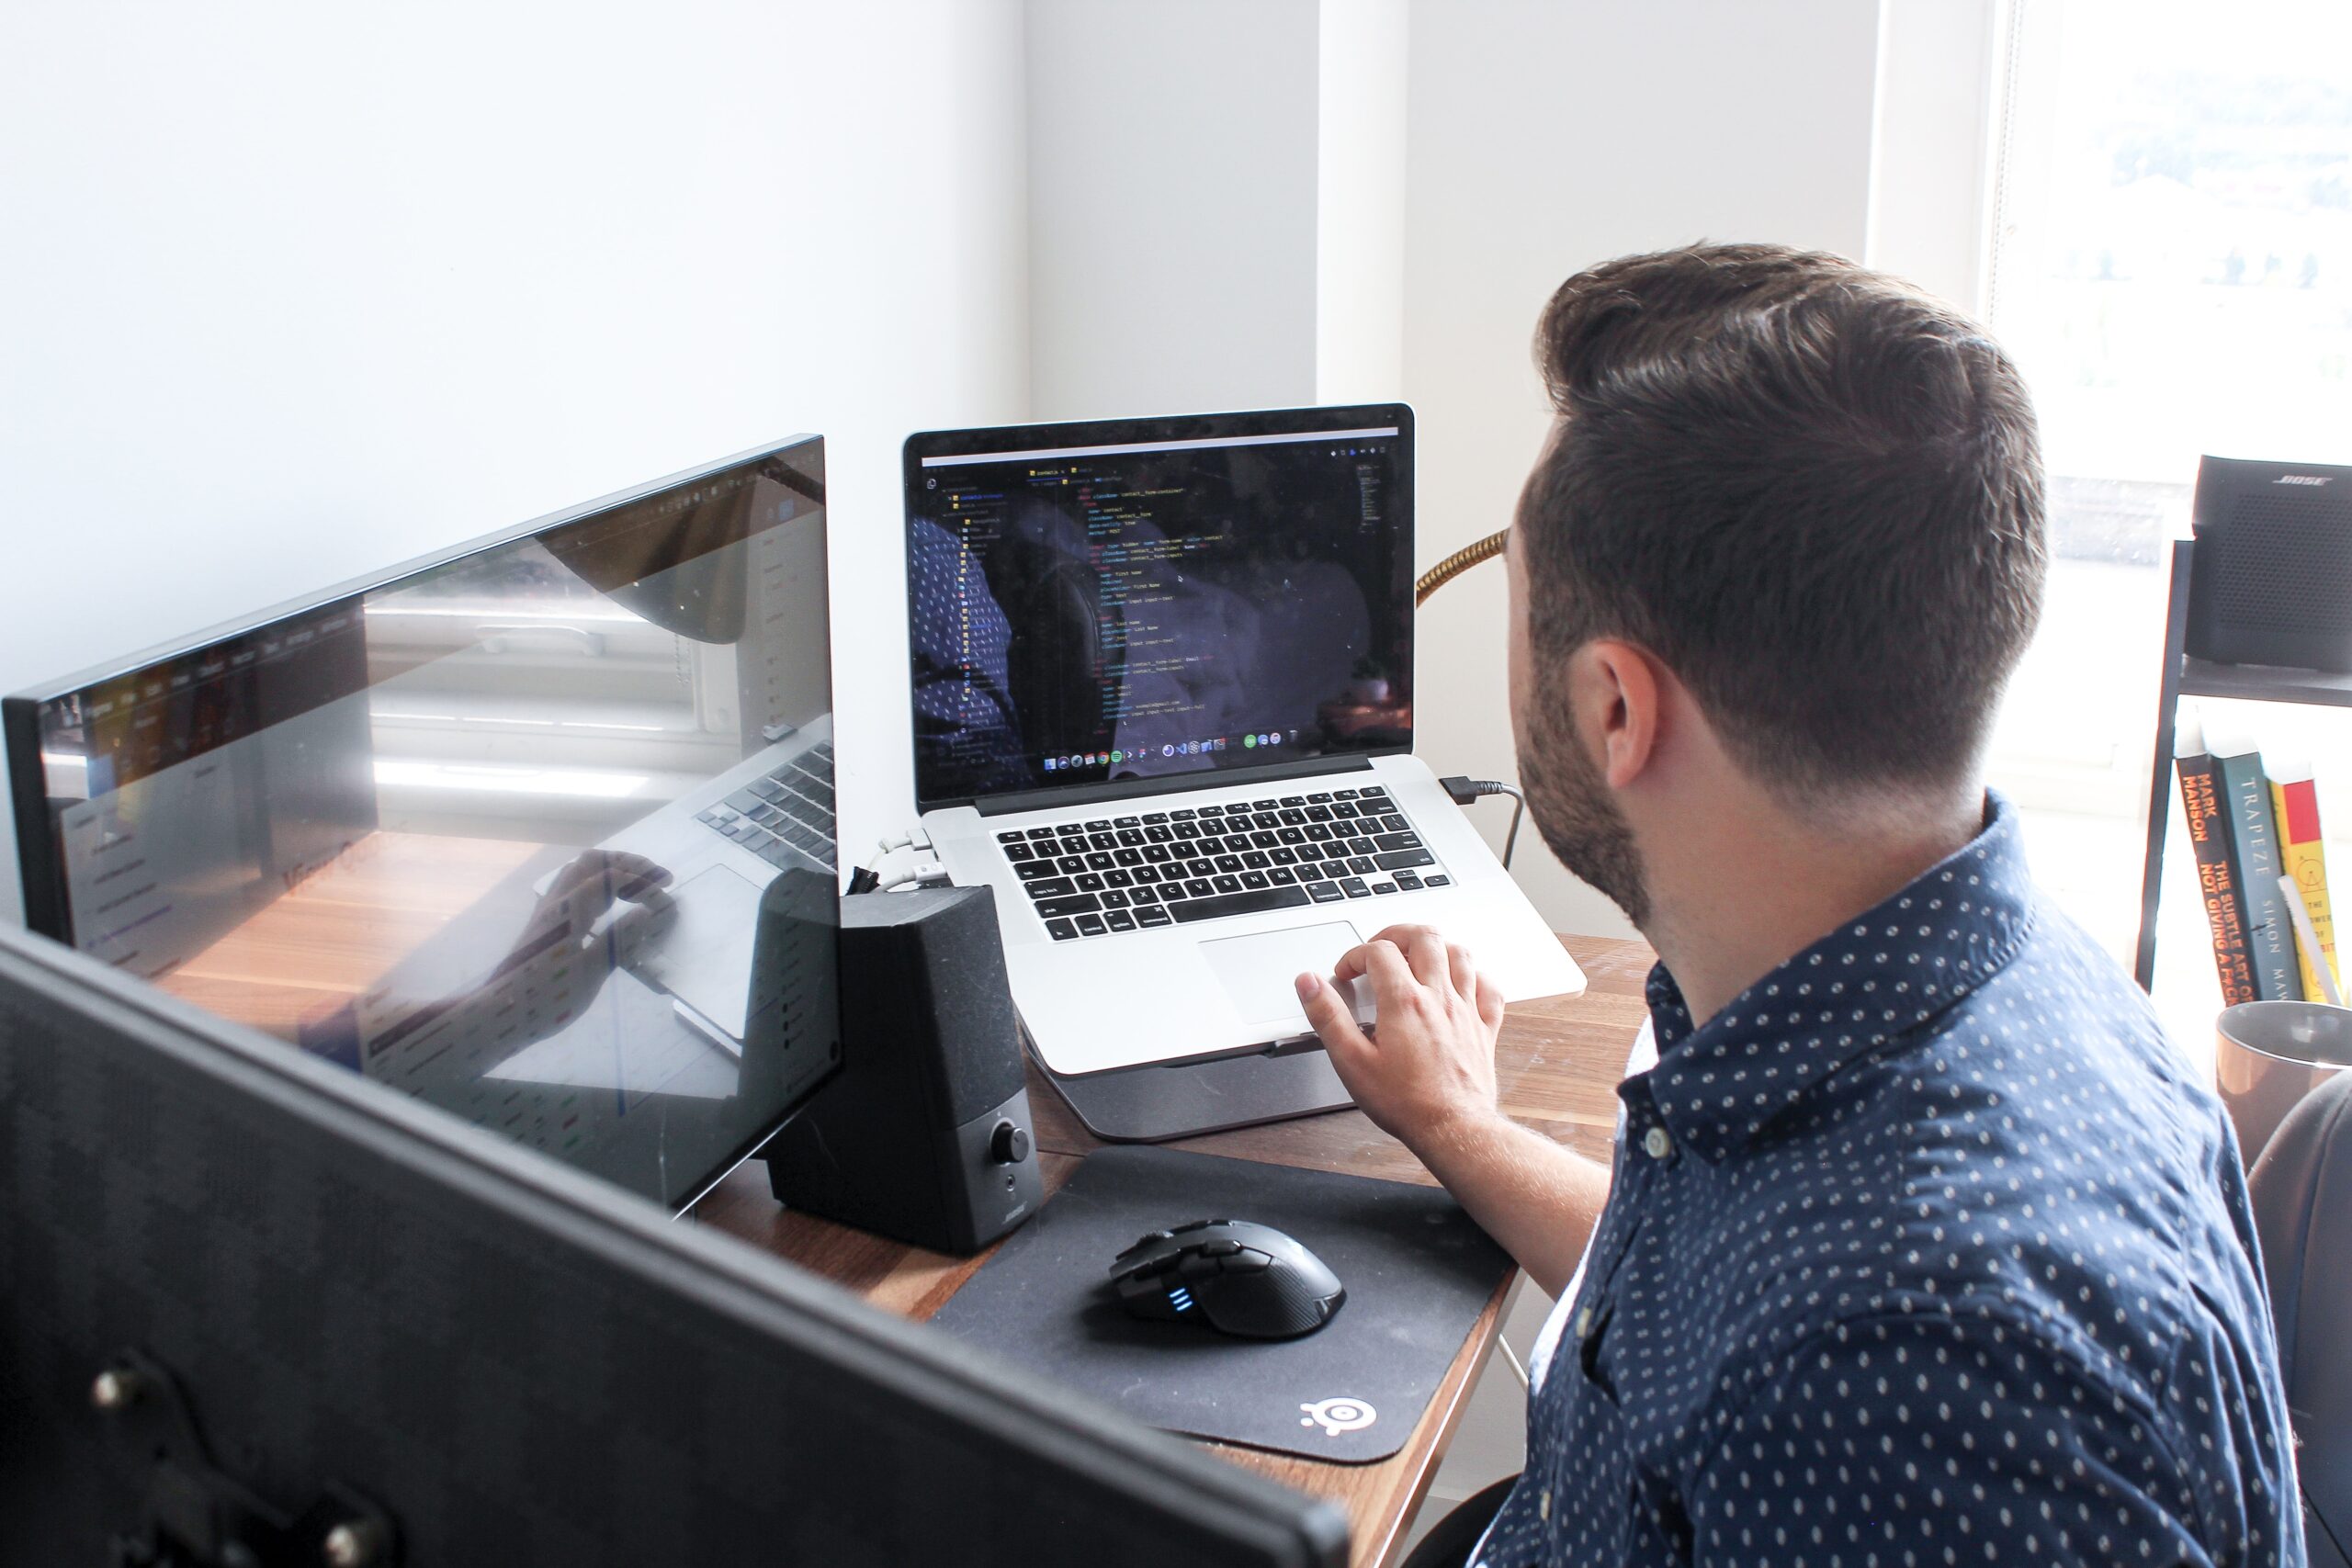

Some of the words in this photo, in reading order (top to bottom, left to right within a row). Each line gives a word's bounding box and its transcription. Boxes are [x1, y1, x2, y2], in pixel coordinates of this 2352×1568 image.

[2272, 475, 2334, 487] BOSE
[2183, 776, 2208, 841] MANSON
[2198, 773, 2217, 817] MARK
[2242, 777, 2270, 874] TRAPEZE
[2200, 863, 2219, 894] NOT
[2214, 861, 2231, 889] THE
[2221, 894, 2243, 948] SUBTLE
[2308, 900, 2323, 909] THE
[2207, 898, 2229, 950] GIVING
[2263, 900, 2280, 953] SIMON
[2218, 953, 2231, 964] A
[2233, 953, 2249, 981] ART
